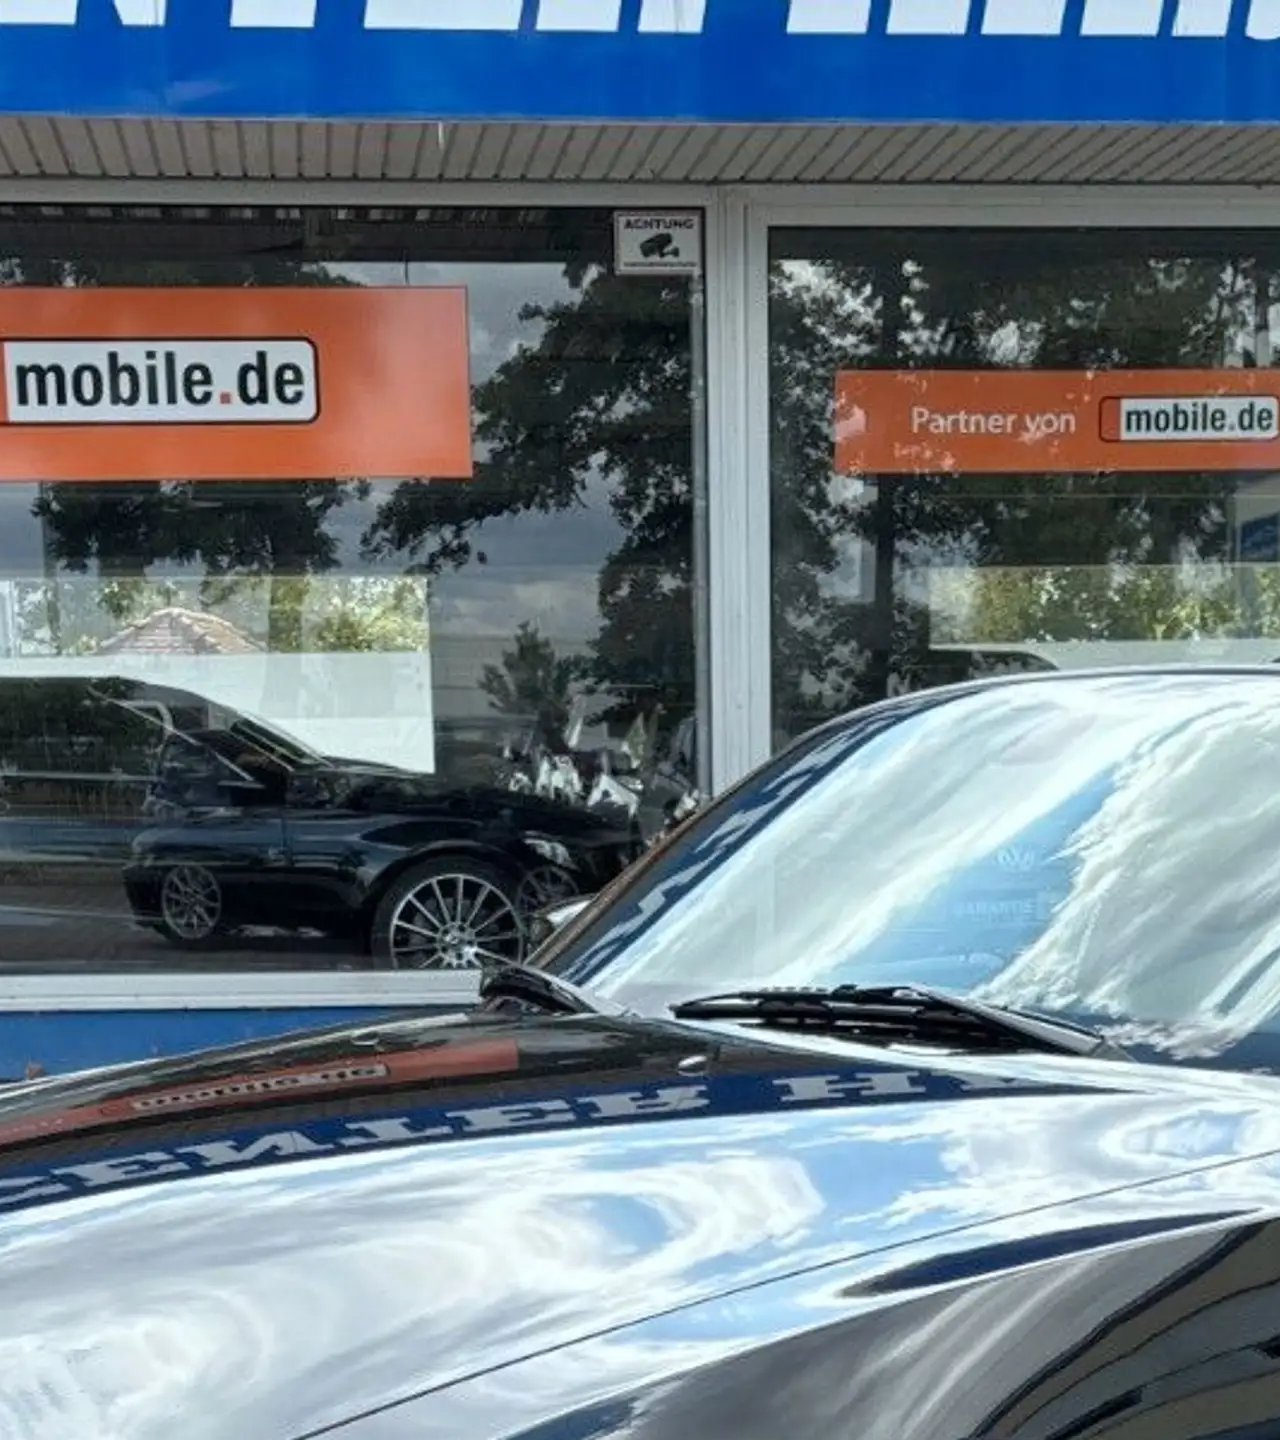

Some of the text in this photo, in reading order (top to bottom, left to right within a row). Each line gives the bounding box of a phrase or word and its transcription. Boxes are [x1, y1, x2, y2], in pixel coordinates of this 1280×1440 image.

[623, 217, 694, 230] ACHTUNG
[15, 350, 306, 407] mobile.de
[910, 402, 1274, 435] Partner von mobile.de
